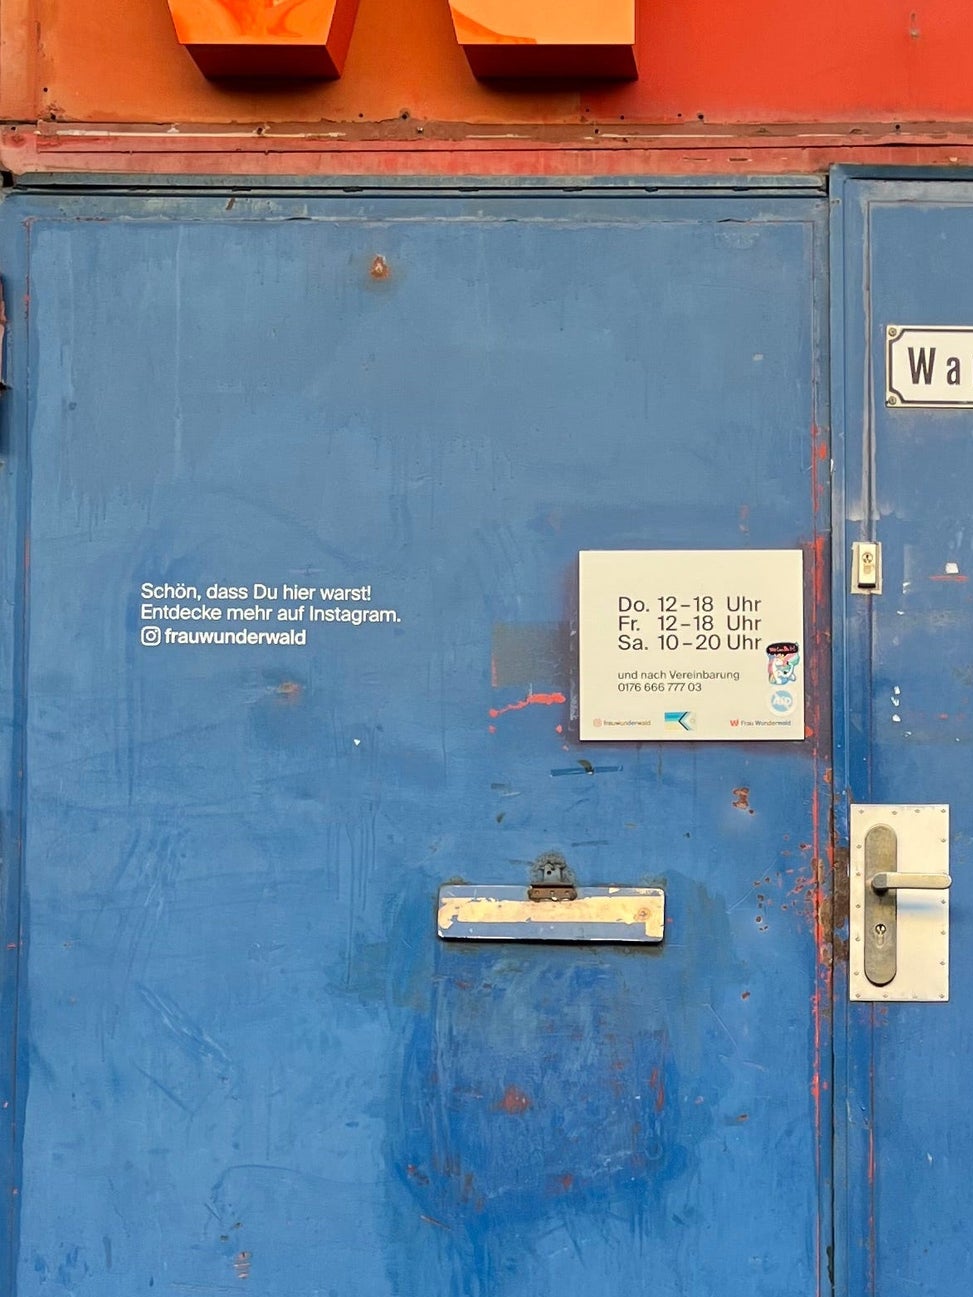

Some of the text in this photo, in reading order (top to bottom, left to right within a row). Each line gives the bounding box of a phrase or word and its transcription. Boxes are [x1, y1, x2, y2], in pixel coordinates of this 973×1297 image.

[140, 582, 372, 601] Schön, dass Du hier warst!
[618, 595, 650, 613] Do.
[726, 595, 762, 613] Uhr
[140, 603, 401, 625] Entdecke mehr auf Instagram.
[618, 614, 641, 632] Fr.
[726, 614, 762, 632] Uhr
[164, 628, 307, 646] frauwunderwald
[617, 633, 649, 651] Sa.
[727, 633, 762, 651] Uhr
[618, 669, 740, 682] und nach Vereinbarung
[618, 682, 702, 693] 0176 666 777 03
